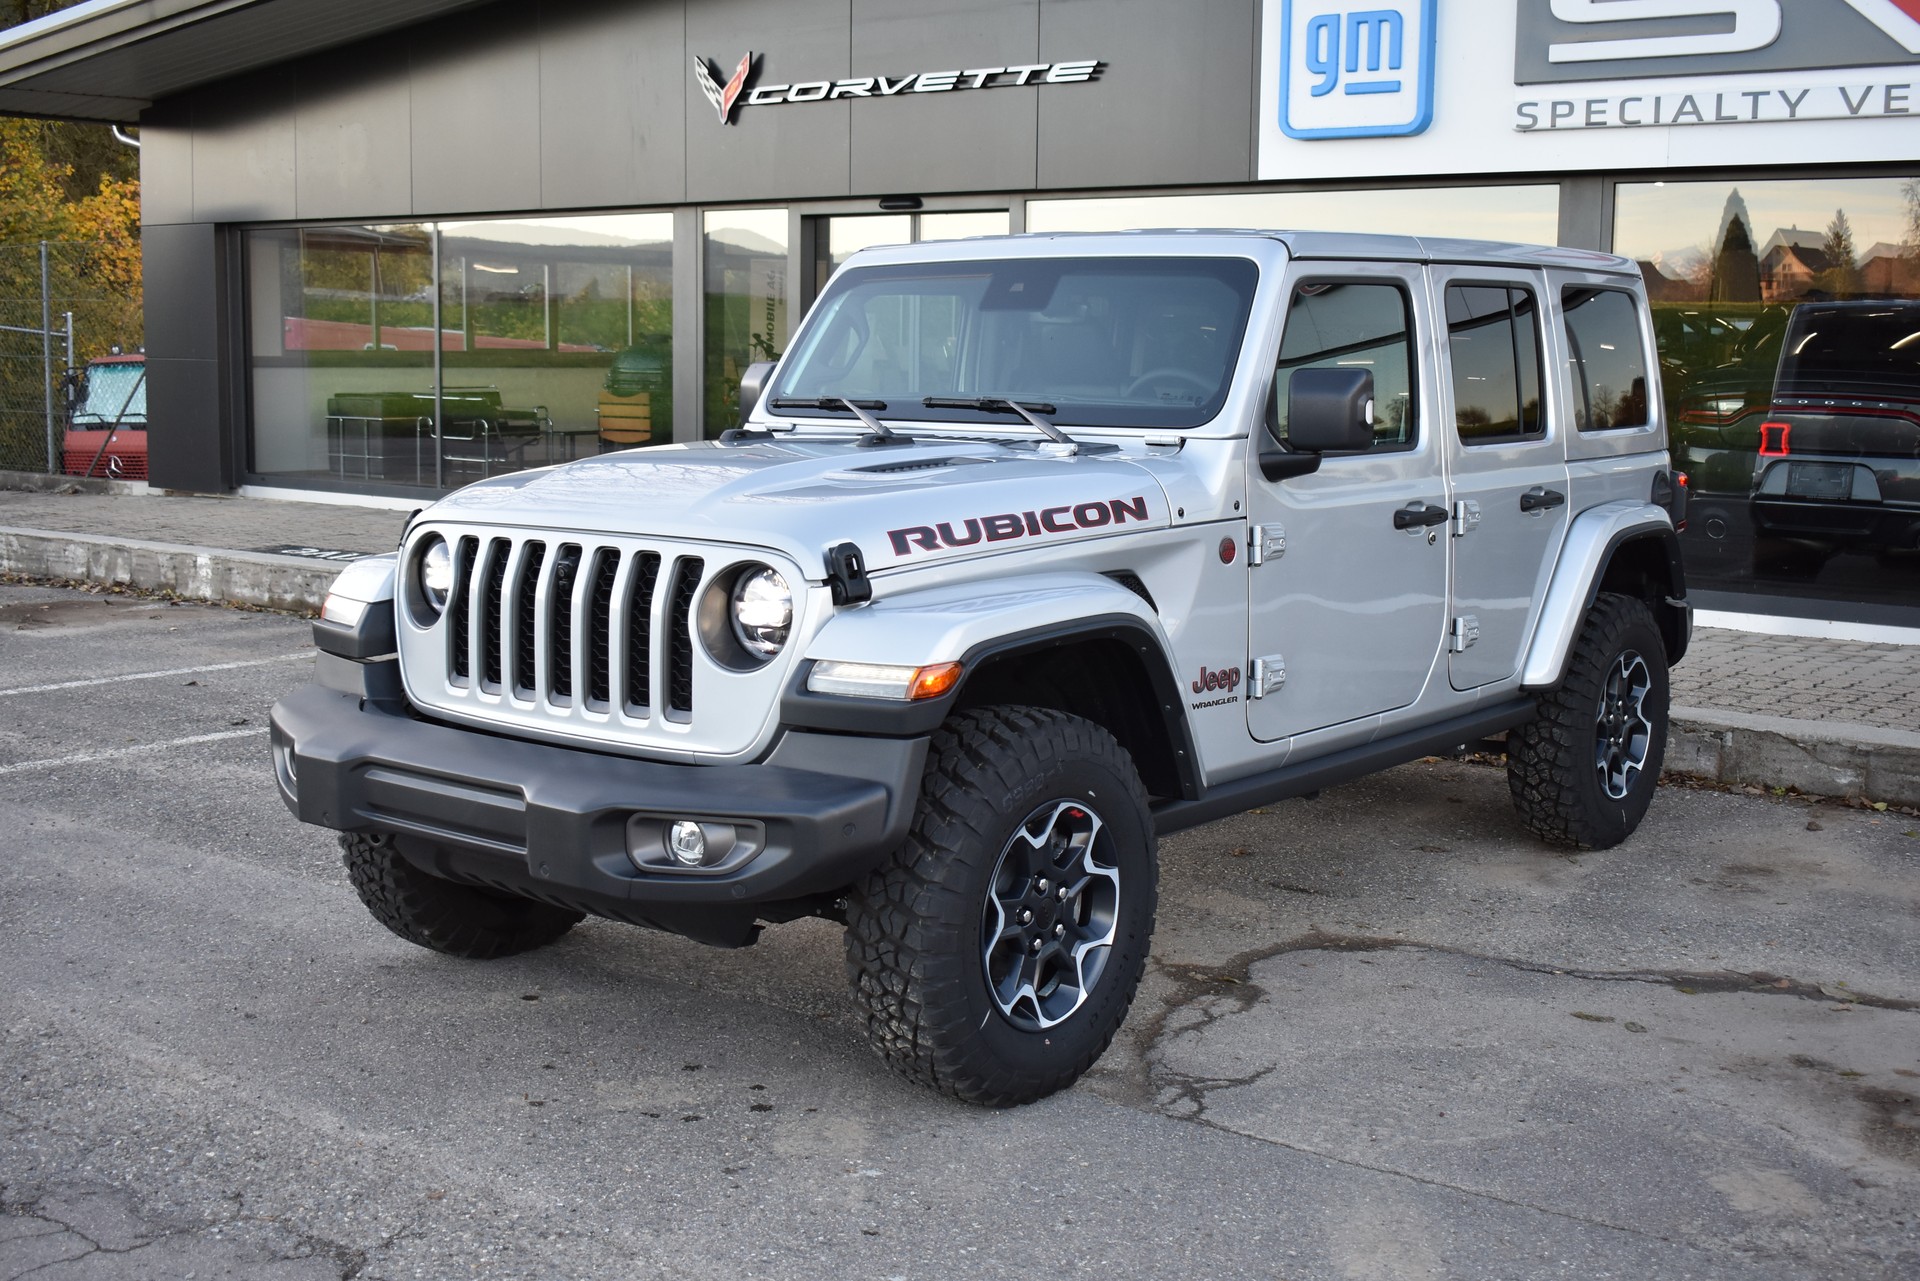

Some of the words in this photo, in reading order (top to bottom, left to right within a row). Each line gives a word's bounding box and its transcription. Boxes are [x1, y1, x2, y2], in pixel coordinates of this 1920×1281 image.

[1306, 9, 1403, 97] gm
[748, 60, 1099, 105] CORVETTE
[1515, 88, 1810, 130] SPECIALTY
[1838, 83, 1911, 115] VE
[886, 496, 1149, 557] RUBICON
[1191, 695, 1238, 710] WRANGLER
[1192, 666, 1241, 694] Jeep
